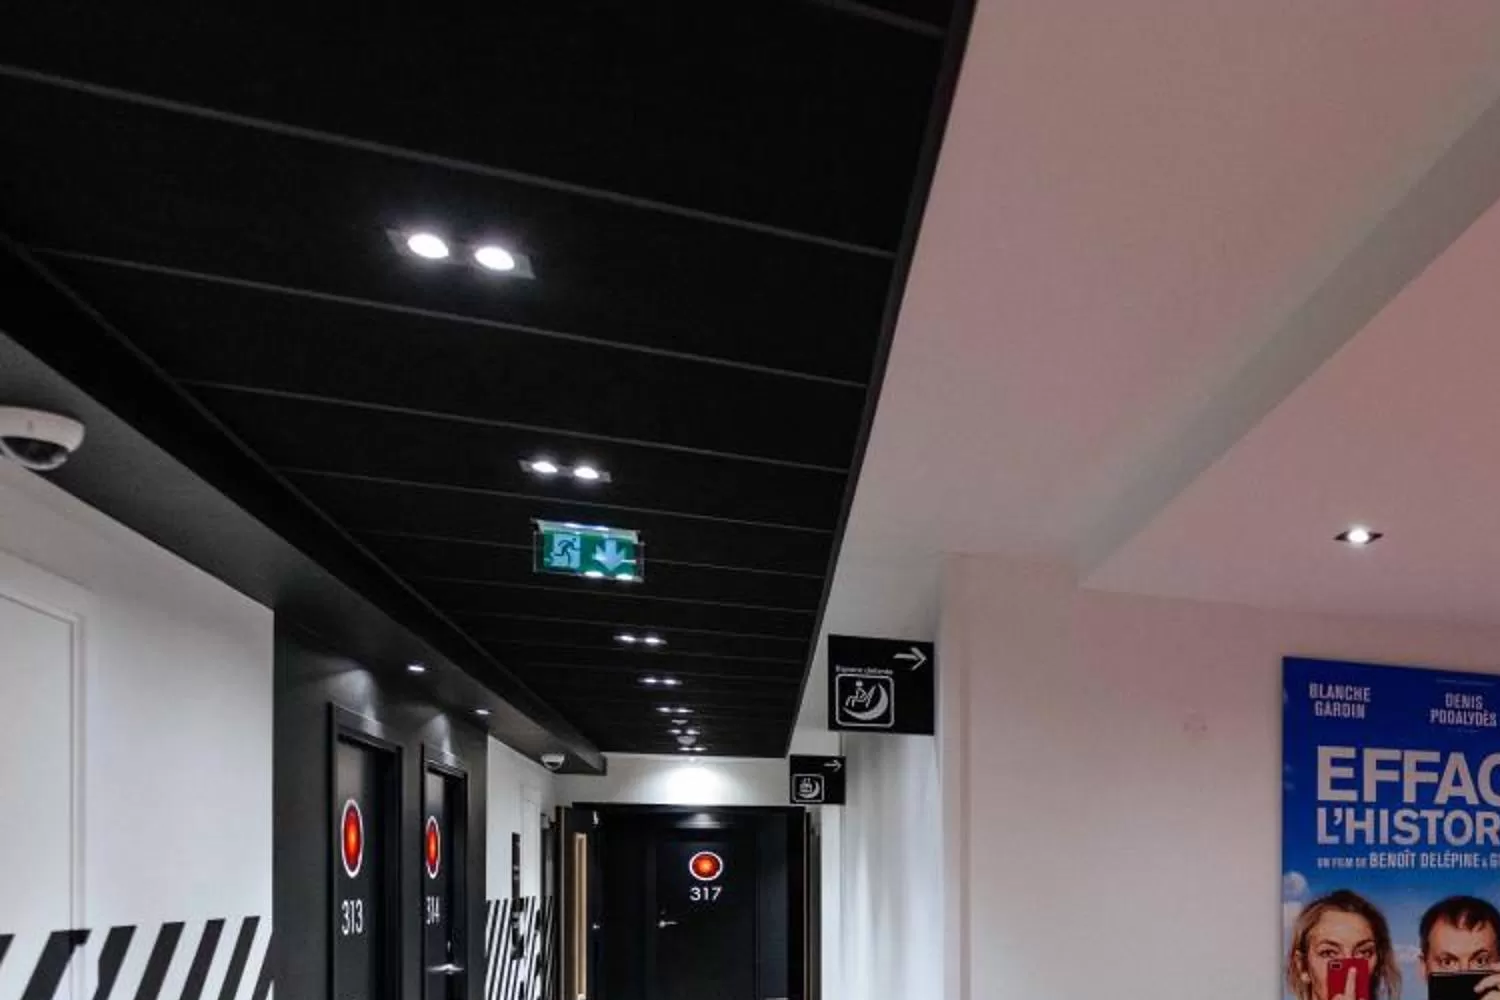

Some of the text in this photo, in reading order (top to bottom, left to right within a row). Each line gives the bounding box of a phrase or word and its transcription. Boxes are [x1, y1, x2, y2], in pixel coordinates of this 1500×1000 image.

[1309, 682, 1371, 702] BLANCHE
[1445, 692, 1483, 710] DENIS
[1315, 700, 1366, 719] GARDIN
[1369, 850, 1416, 869] BENOÎT
[1420, 851, 1480, 869] DELÉPINE
[689, 886, 723, 902] 317
[341, 899, 364, 935] 313
[425, 896, 440, 925] 314
